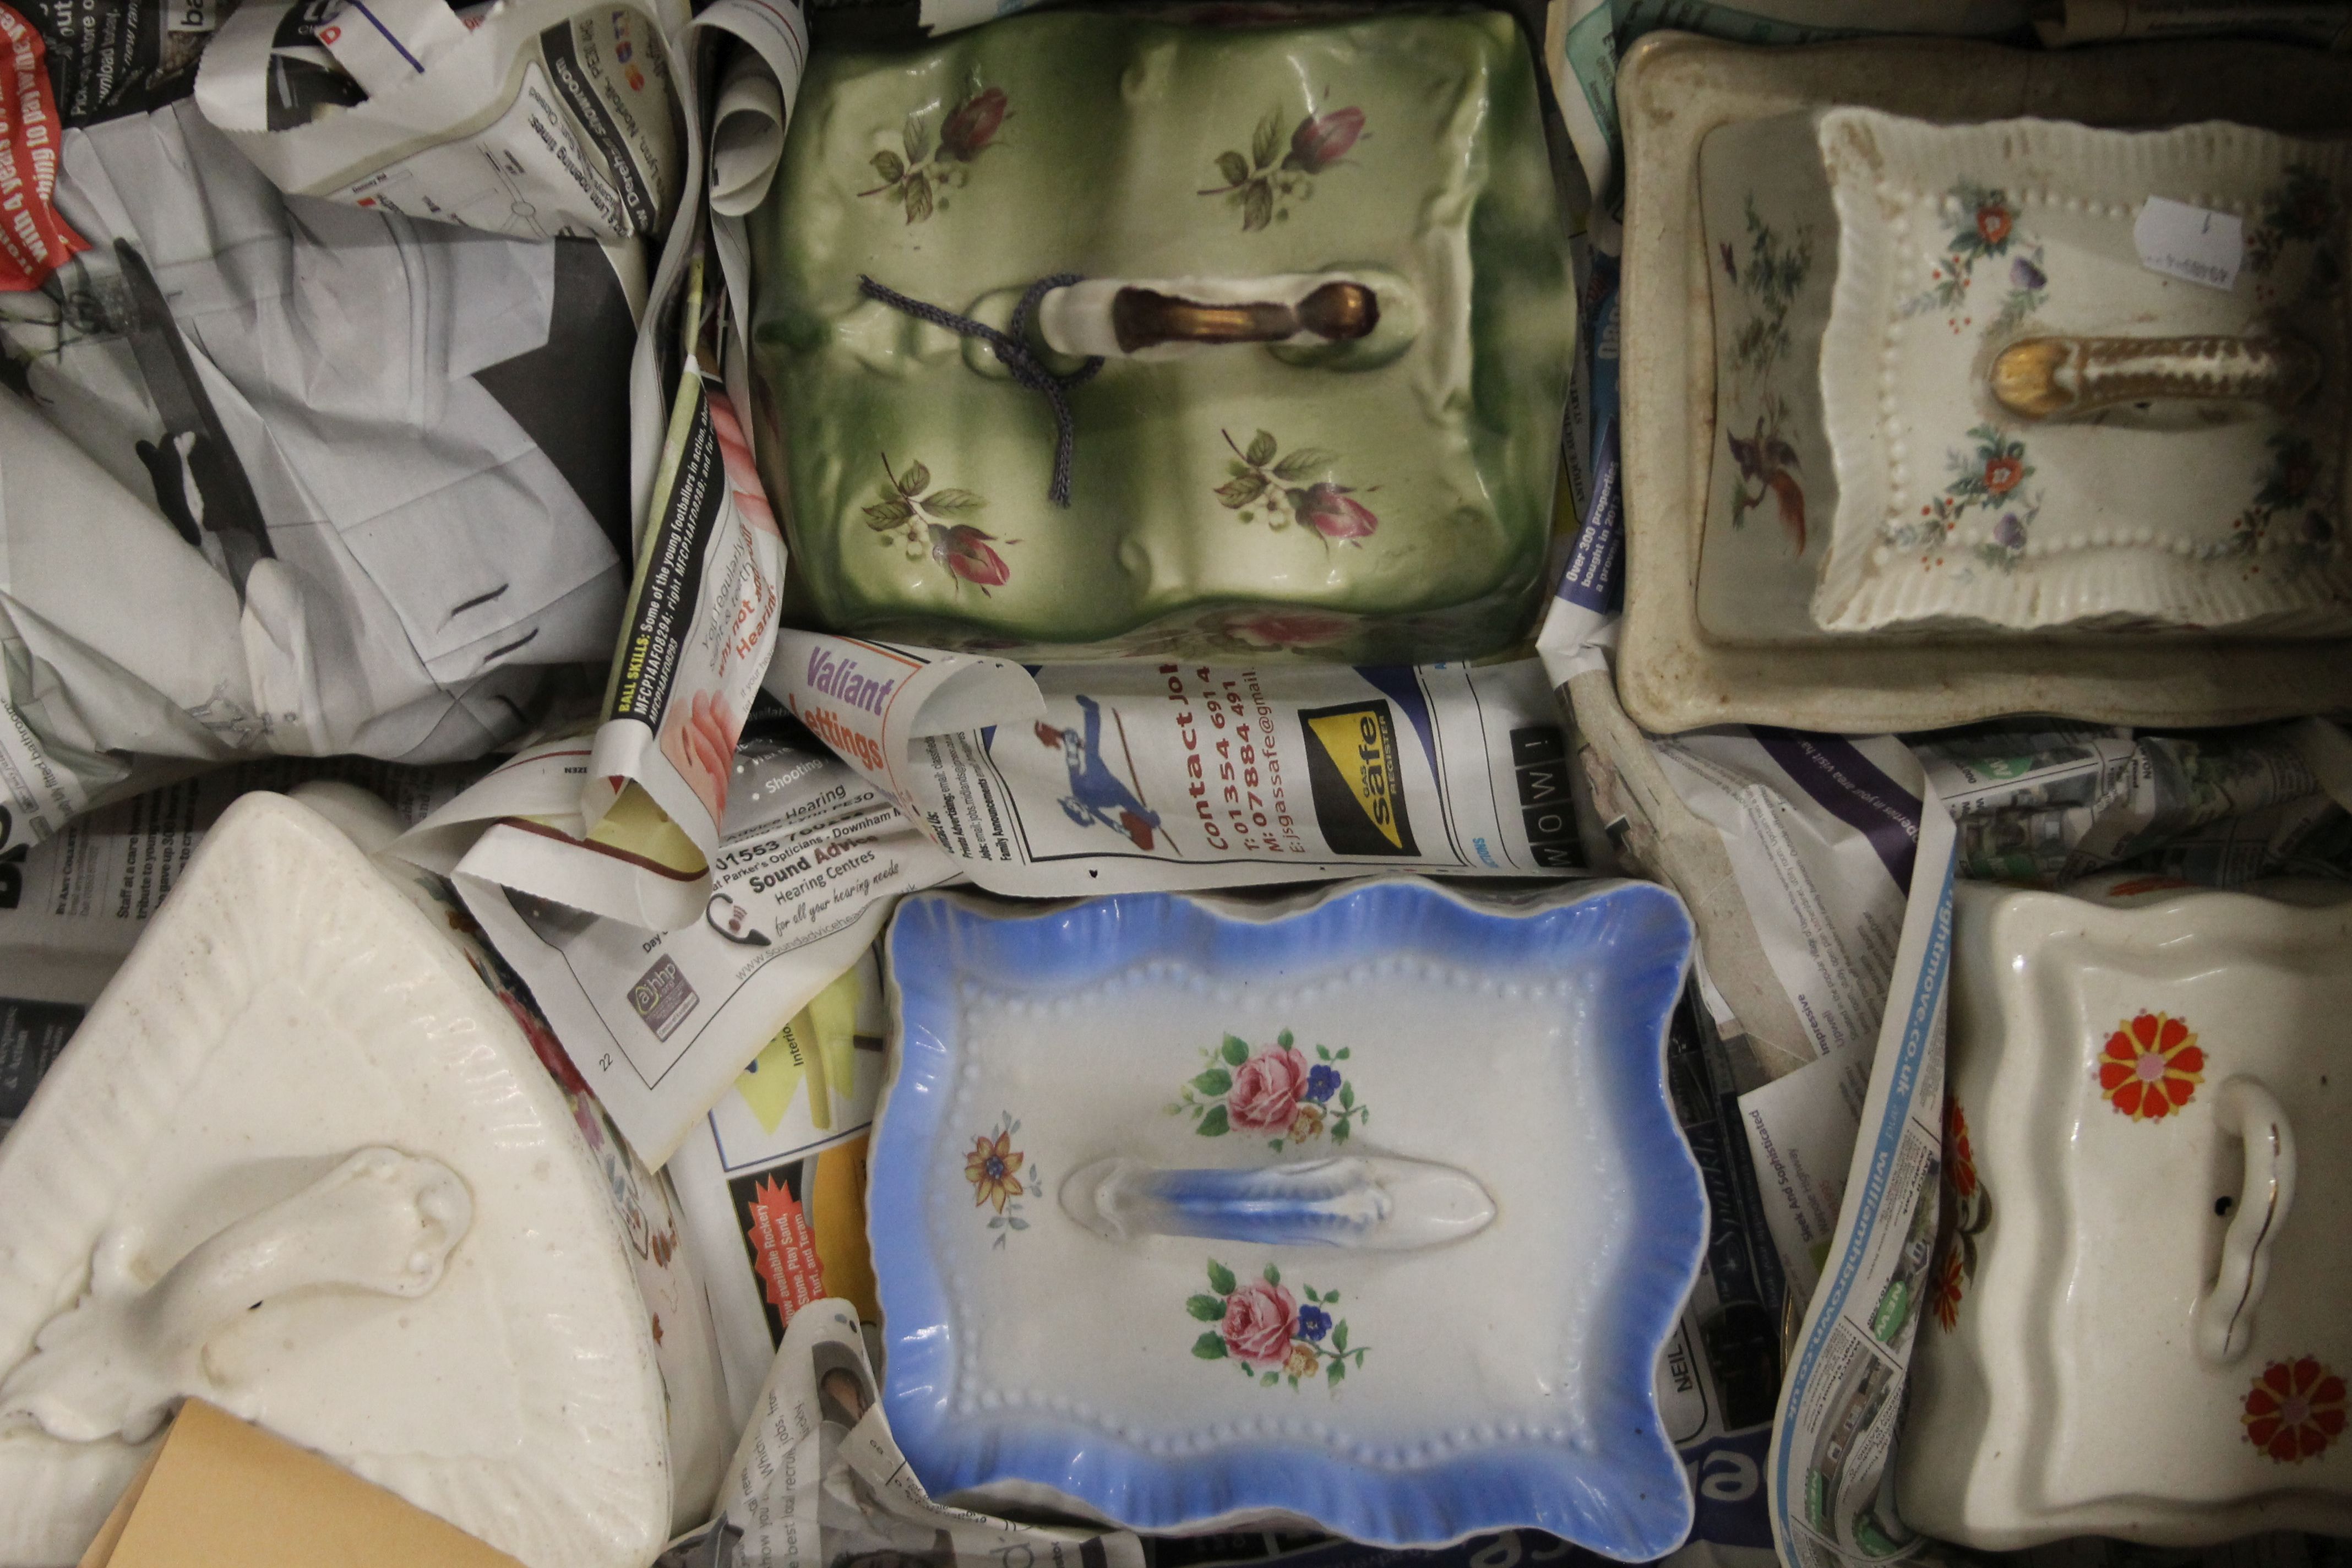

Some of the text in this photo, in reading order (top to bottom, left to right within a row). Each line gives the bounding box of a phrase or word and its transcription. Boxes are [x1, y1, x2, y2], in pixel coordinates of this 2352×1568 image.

[21, 90, 47, 125] pay
[26, 126, 49, 147] to
[527, 113, 557, 153] times:
[555, 57, 640, 207] Dereham showroom
[556, 145, 591, 193] opening
[3, 194, 24, 210] 4
[14, 210, 48, 264] with
[667, 578, 682, 611] right
[701, 453, 711, 479] and
[1565, 461, 1619, 582] Over 300 properties
[618, 427, 706, 712] BALL SKILLS: Some of the young footballers in action,
[1580, 543, 1605, 588] bought
[1598, 529, 1610, 542] in
[1596, 584, 1604, 592] a
[733, 598, 755, 635] not
[746, 671, 760, 693] your
[806, 645, 895, 716] Valiant
[1203, 691, 1226, 729] 691
[789, 693, 885, 770] Lettings
[40, 761, 59, 788] fitted
[765, 757, 824, 794] Shooting
[1222, 680, 1284, 853] M: 07884 491
[1358, 715, 1391, 826] safe
[1378, 715, 1398, 796] REGISTER
[1811, 750, 1835, 774] visit
[934, 771, 951, 793] email:
[1175, 711, 1229, 851] Contact
[1216, 737, 1249, 834] 01354
[1360, 765, 1370, 798] GAS
[1833, 771, 1854, 791] area
[1855, 787, 1879, 805] your
[786, 784, 847, 820] Hearing
[943, 793, 964, 836] Advertising:
[977, 777, 1012, 861] Family Announcements
[126, 835, 140, 865] care
[162, 847, 174, 862] up
[178, 847, 189, 861] to
[715, 840, 781, 872] 01553
[722, 861, 769, 885] Parker's
[771, 836, 824, 864] Opticians
[832, 809, 892, 839] Downham
[978, 842, 992, 861] Jobs:
[1244, 838, 1260, 852] T:
[1781, 829, 1798, 857] Outside
[123, 875, 134, 889] at
[143, 863, 154, 876] to
[157, 864, 173, 892] gave
[748, 835, 879, 894] Sound Advice
[774, 850, 876, 906] Hearing Centres
[116, 889, 133, 919] Staff
[135, 877, 153, 921] tribute
[775, 859, 900, 938] for all your hearing needs
[643, 933, 662, 954] Day
[782, 1023, 804, 1067] Interio
[1796, 993, 1828, 1057] Impressive
[1822, 1009, 1845, 1048] Upwell
[599, 1052, 614, 1072] 22
[1749, 1109, 1814, 1243] Sleek And Sophisticated
[757, 1204, 790, 1298] available Rockery
[776, 1212, 810, 1306] Stone, Play Sand,
[802, 1248, 816, 1269] and
[1787, 1151, 1889, 1421] williamhbrown.co.uk
[1877, 1282, 1903, 1337] NEW
[1667, 1343, 1694, 1394] NEIL
[775, 1414, 798, 1559] best local jobs,
